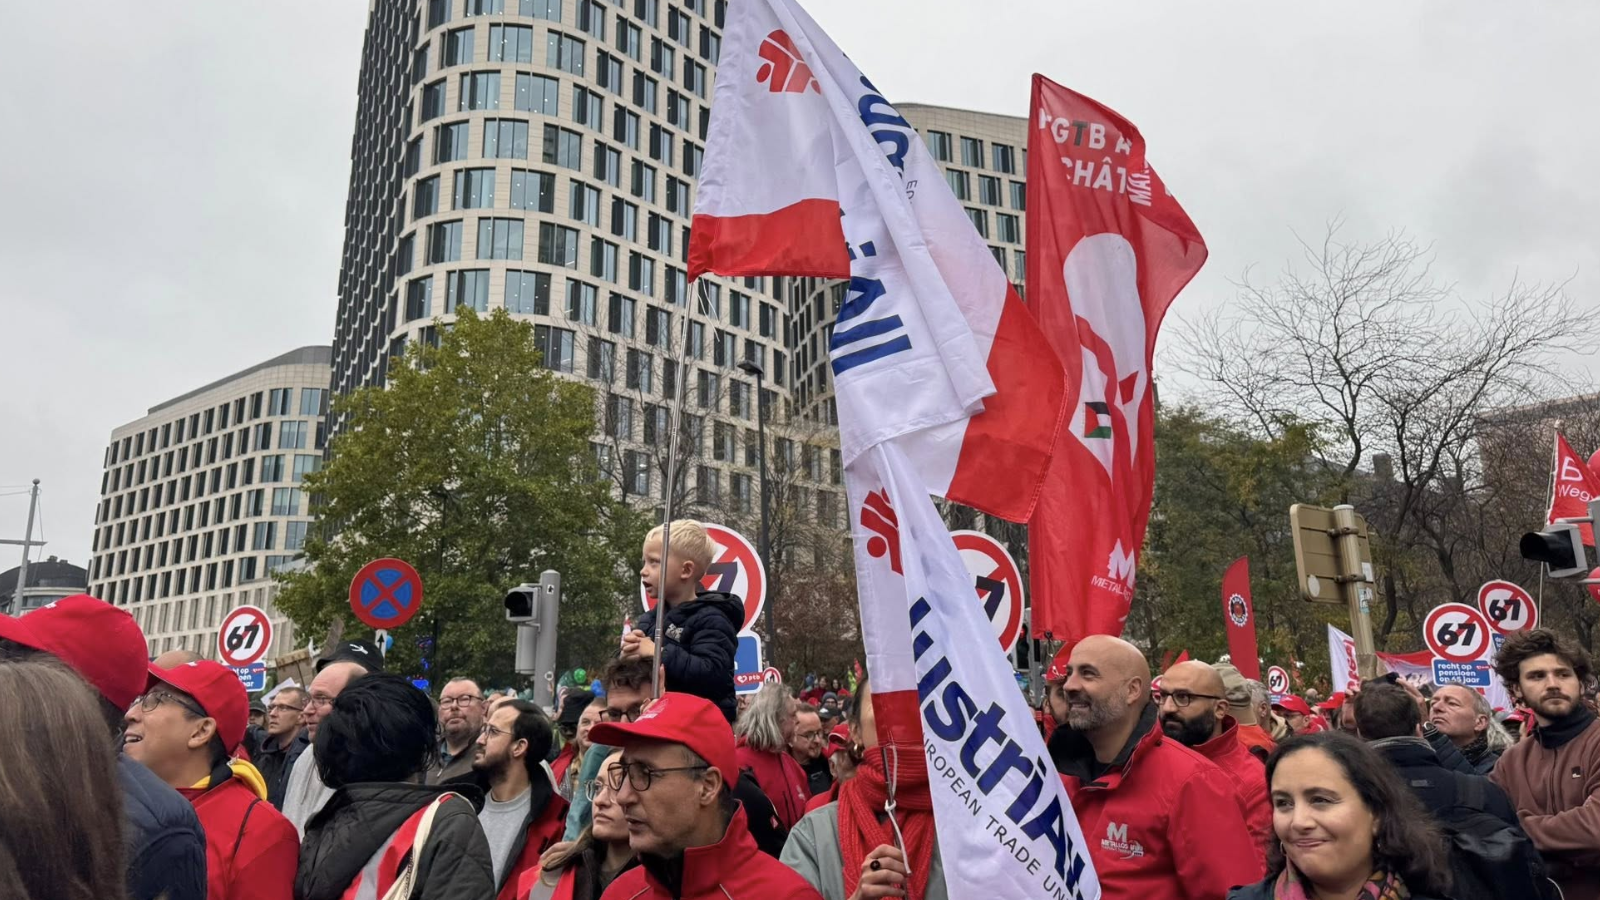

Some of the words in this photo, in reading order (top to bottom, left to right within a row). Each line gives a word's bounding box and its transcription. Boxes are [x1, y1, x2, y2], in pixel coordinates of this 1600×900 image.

[1038, 108, 1106, 149] FGTB
[1557, 484, 1594, 502] Weg
[699, 561, 739, 593] 7
[975, 575, 1005, 623] 7
[1489, 598, 1522, 621] 67
[227, 625, 260, 651] 67
[1437, 622, 1477, 646] 67
[1269, 675, 1283, 688] 67
[985, 814, 1042, 876] TRADE
[1043, 875, 1069, 900] UN
